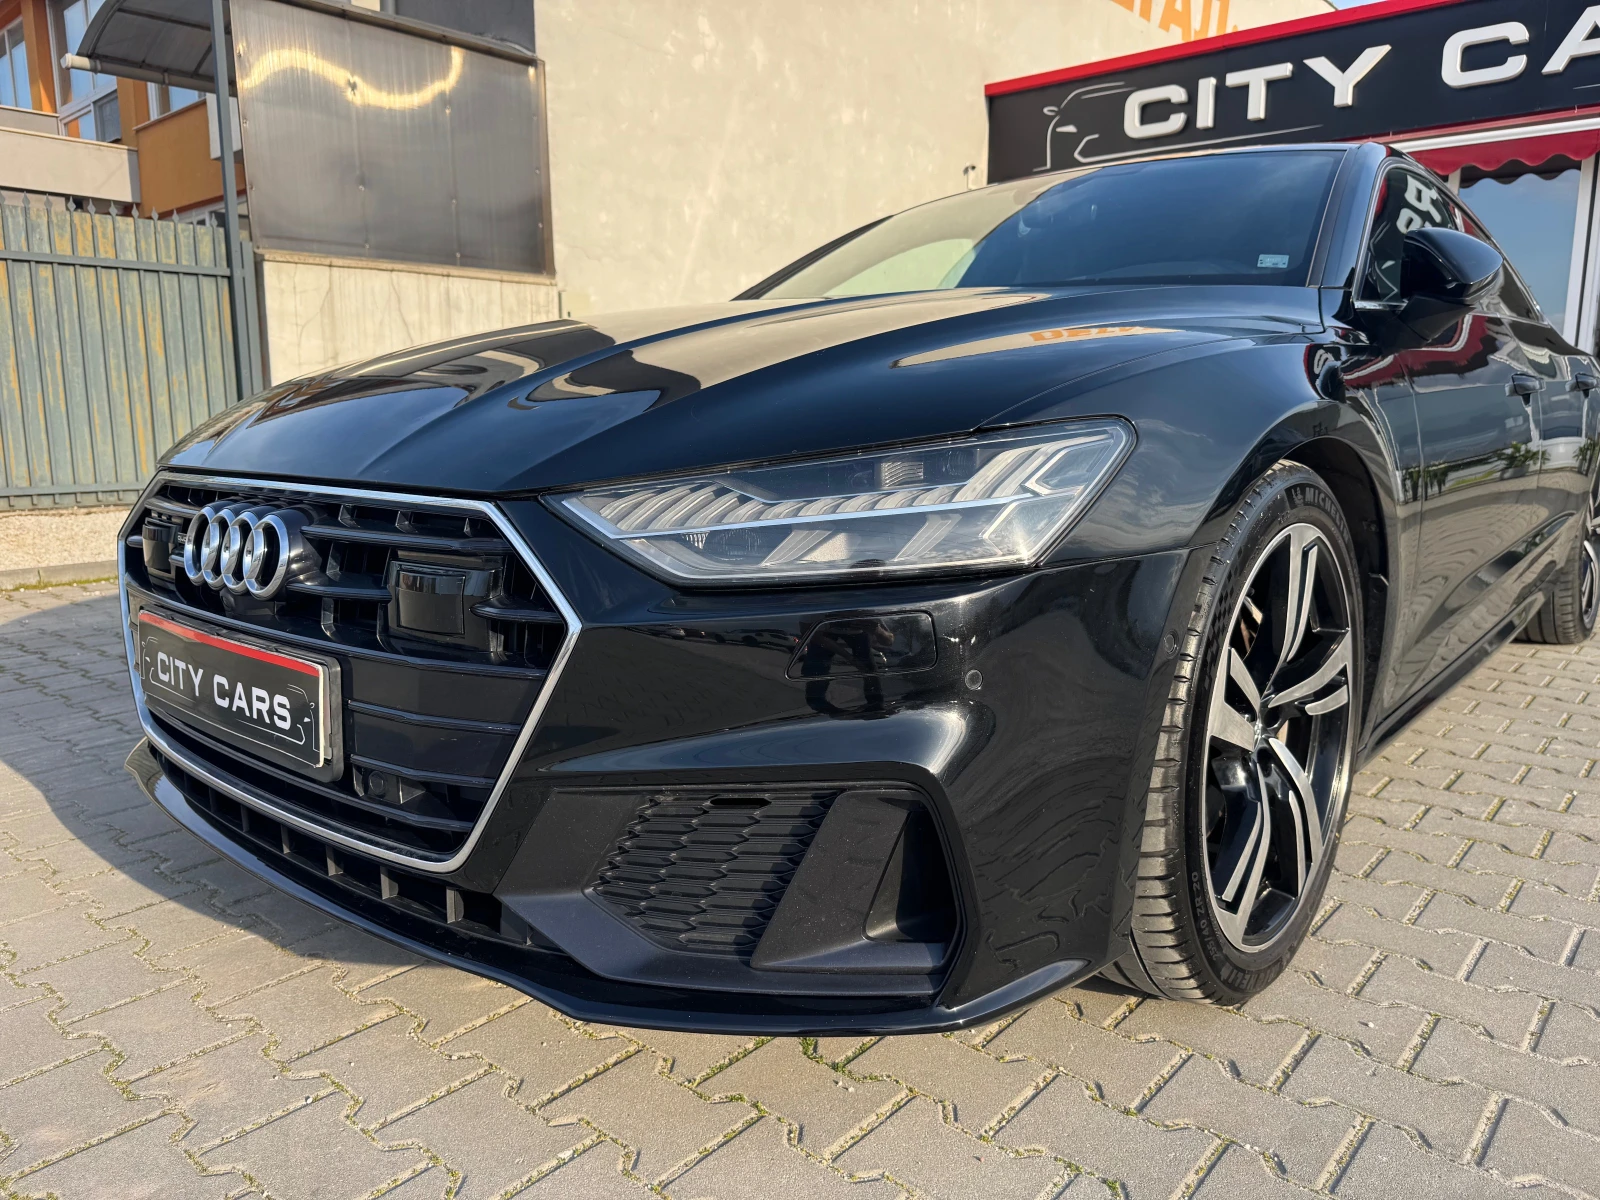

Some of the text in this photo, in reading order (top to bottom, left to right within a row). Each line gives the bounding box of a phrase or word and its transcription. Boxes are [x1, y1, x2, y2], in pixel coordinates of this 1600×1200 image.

[1124, 45, 1392, 139] CITY
[1305, 487, 1349, 544] MICHELIN
[157, 652, 291, 731] CITY CARS
[1191, 871, 1201, 891] 20
